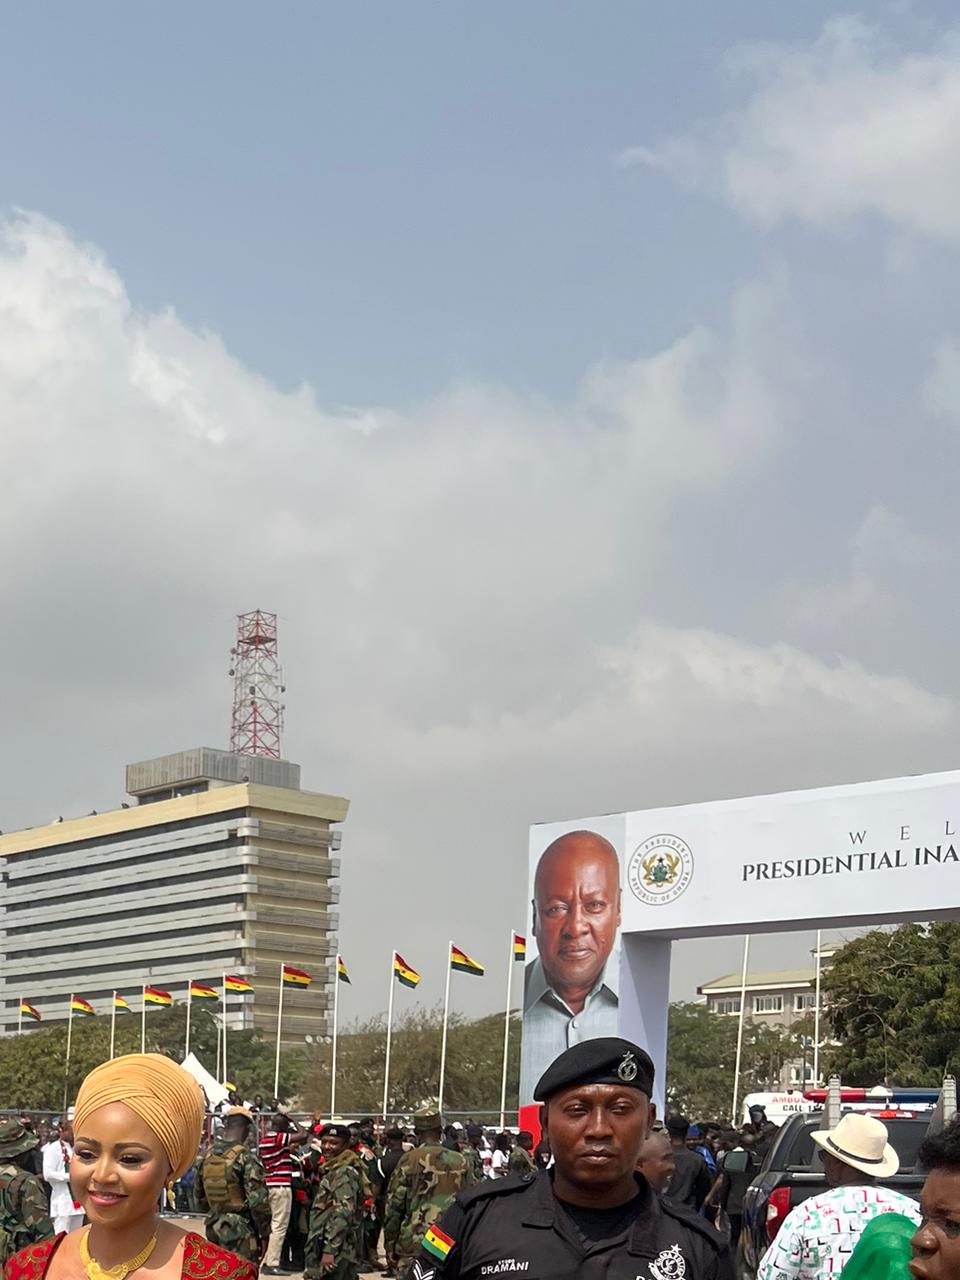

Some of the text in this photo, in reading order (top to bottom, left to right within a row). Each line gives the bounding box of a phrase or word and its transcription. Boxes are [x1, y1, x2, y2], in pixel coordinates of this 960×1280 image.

[645, 838, 690, 864] PRESIDENCY
[742, 844, 960, 882] PRESIDENTIAL INA
[632, 877, 659, 902] REPUBLIC
[481, 1261, 529, 1275] DRAMANI
